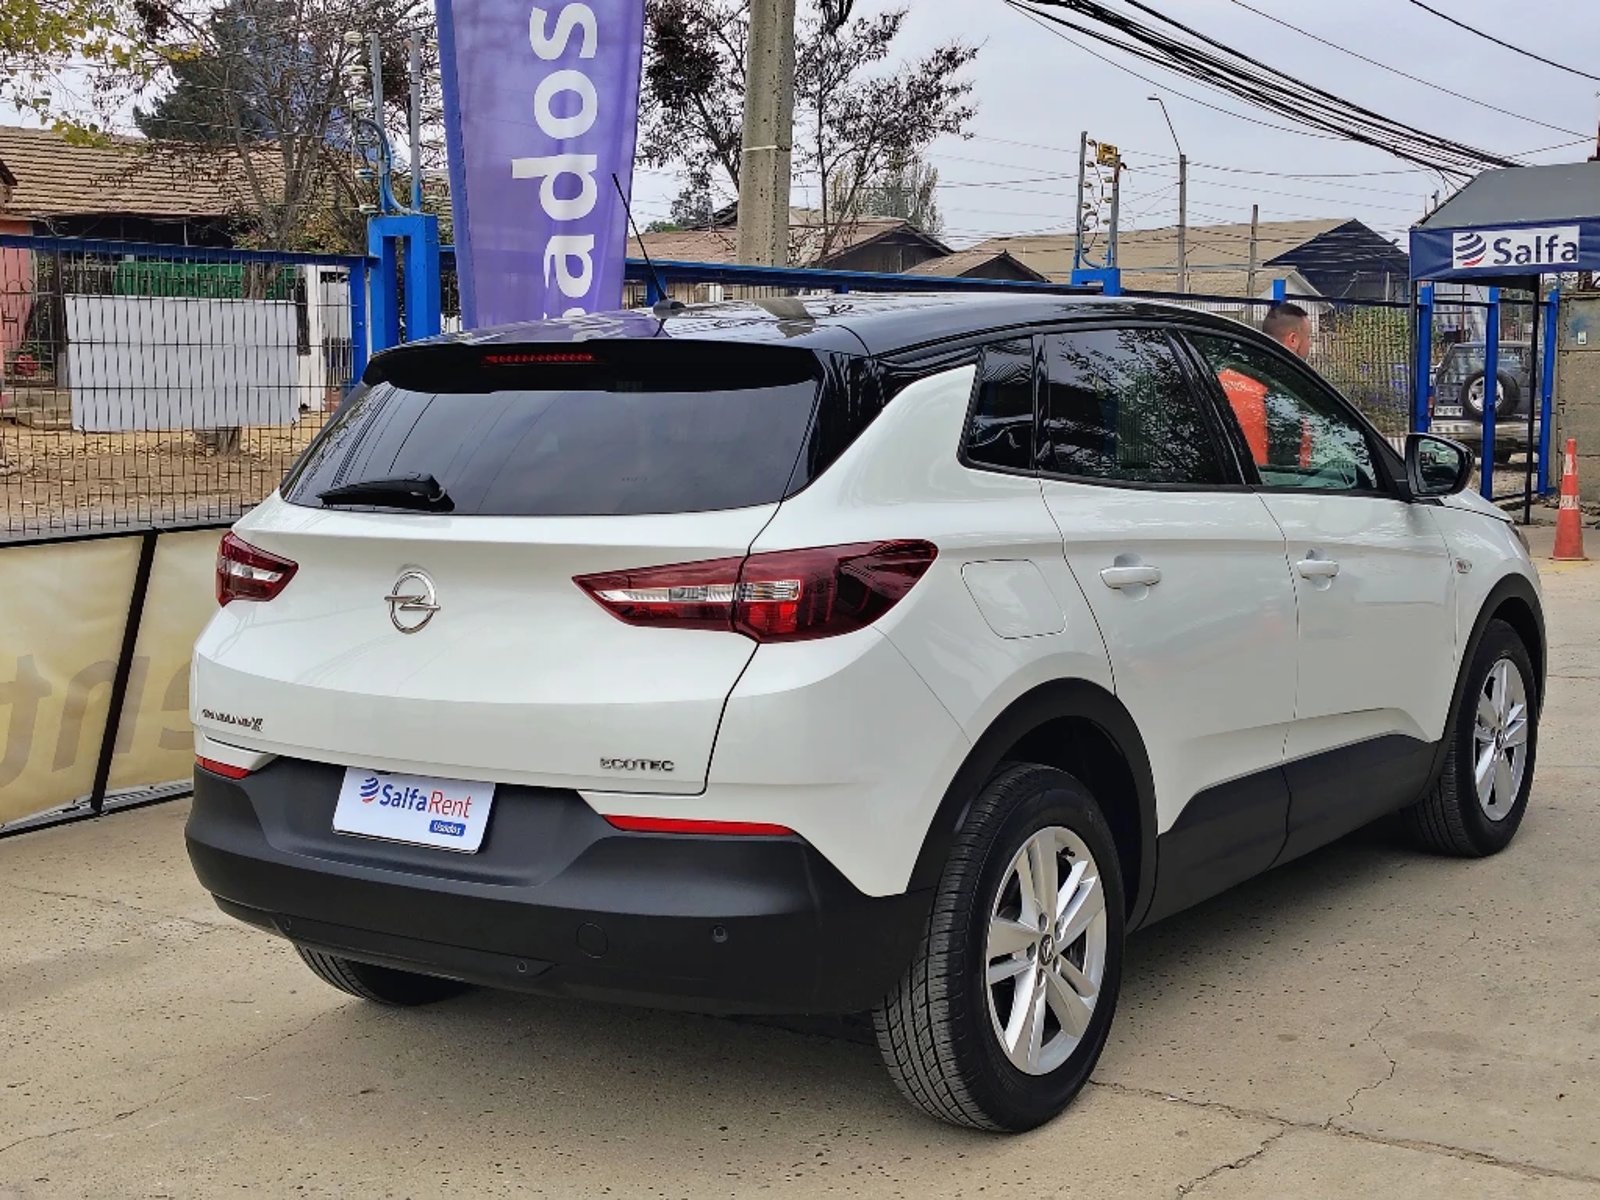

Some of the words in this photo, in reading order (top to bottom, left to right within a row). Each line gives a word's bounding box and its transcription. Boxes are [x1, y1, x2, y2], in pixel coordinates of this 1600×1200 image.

[512, 2, 598, 319] ados
[1493, 234, 1578, 265] Salfa
[600, 758, 674, 772] ECOTEC
[380, 784, 472, 818] SalfaRent
